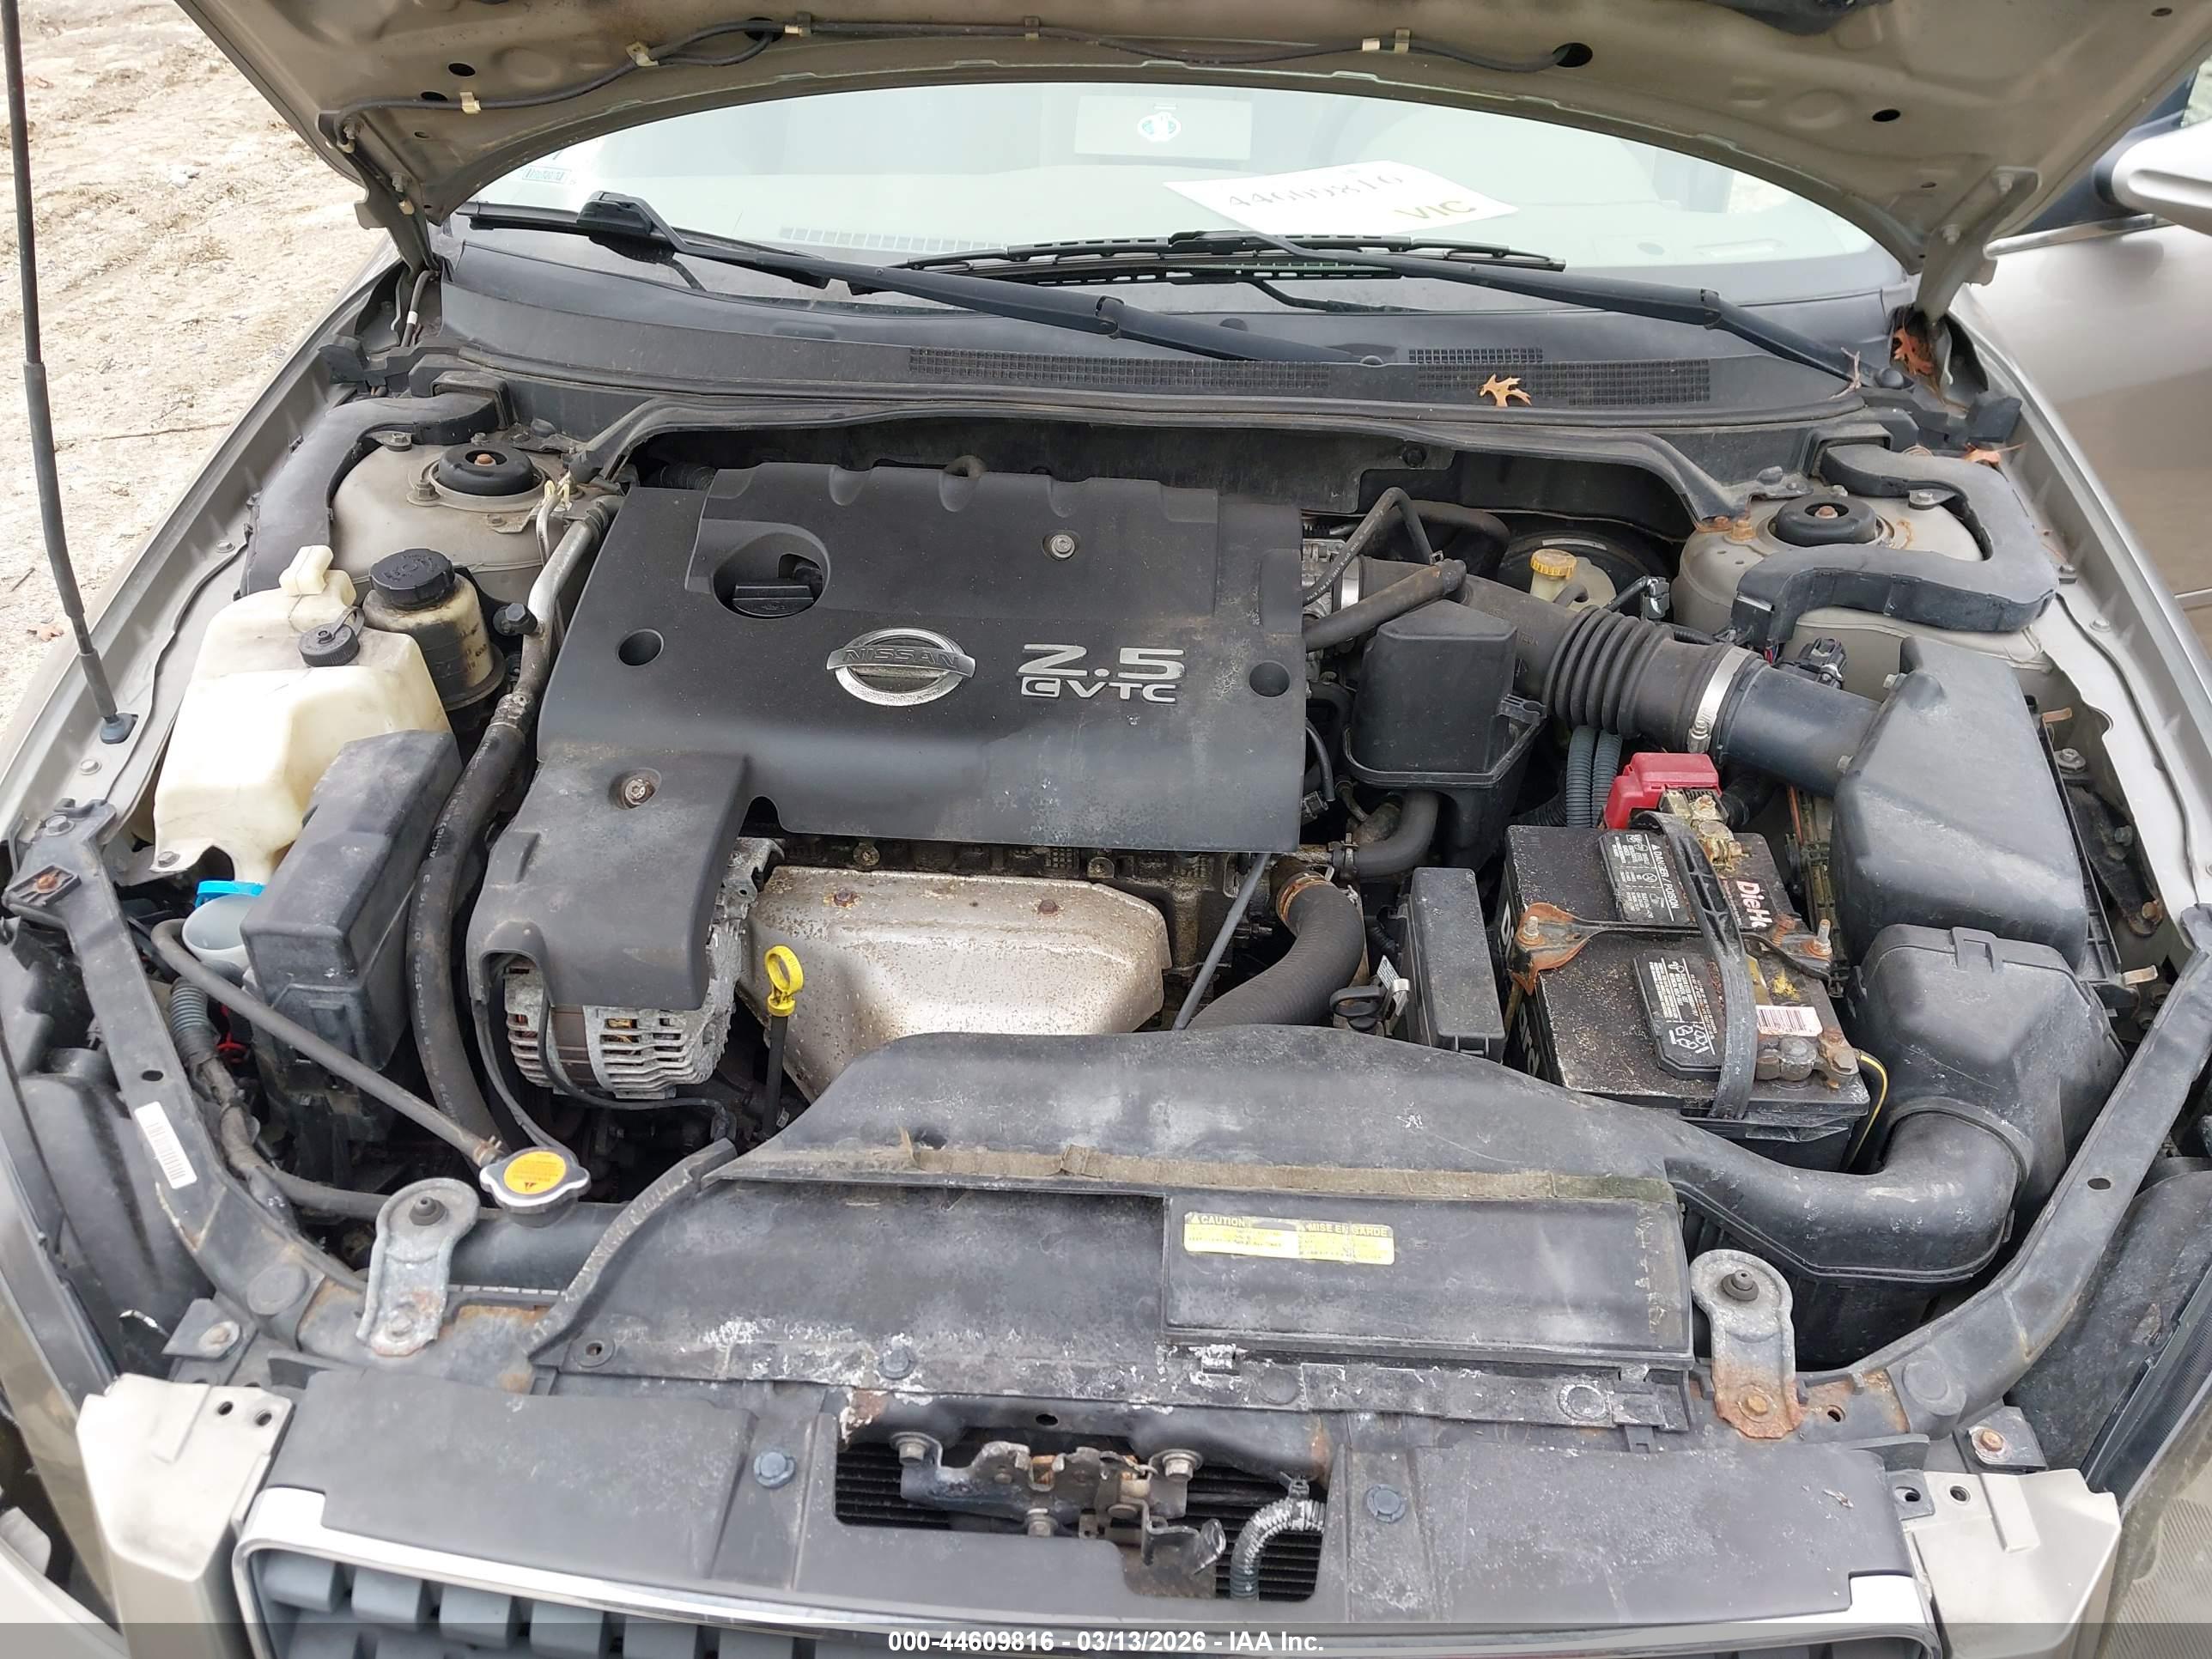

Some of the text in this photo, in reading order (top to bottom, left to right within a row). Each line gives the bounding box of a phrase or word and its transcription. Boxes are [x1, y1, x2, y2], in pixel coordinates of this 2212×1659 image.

[1395, 199, 1477, 221] VIC
[842, 647, 958, 671] NISSAN
[1018, 643, 1186, 681] 2.5
[1021, 676, 1177, 703] CVTC
[1653, 850, 1670, 880] DANGER
[1665, 884, 1680, 909] POISON
[1200, 1213, 1247, 1228] CAUTION
[1308, 1223, 1334, 1234] MISE
